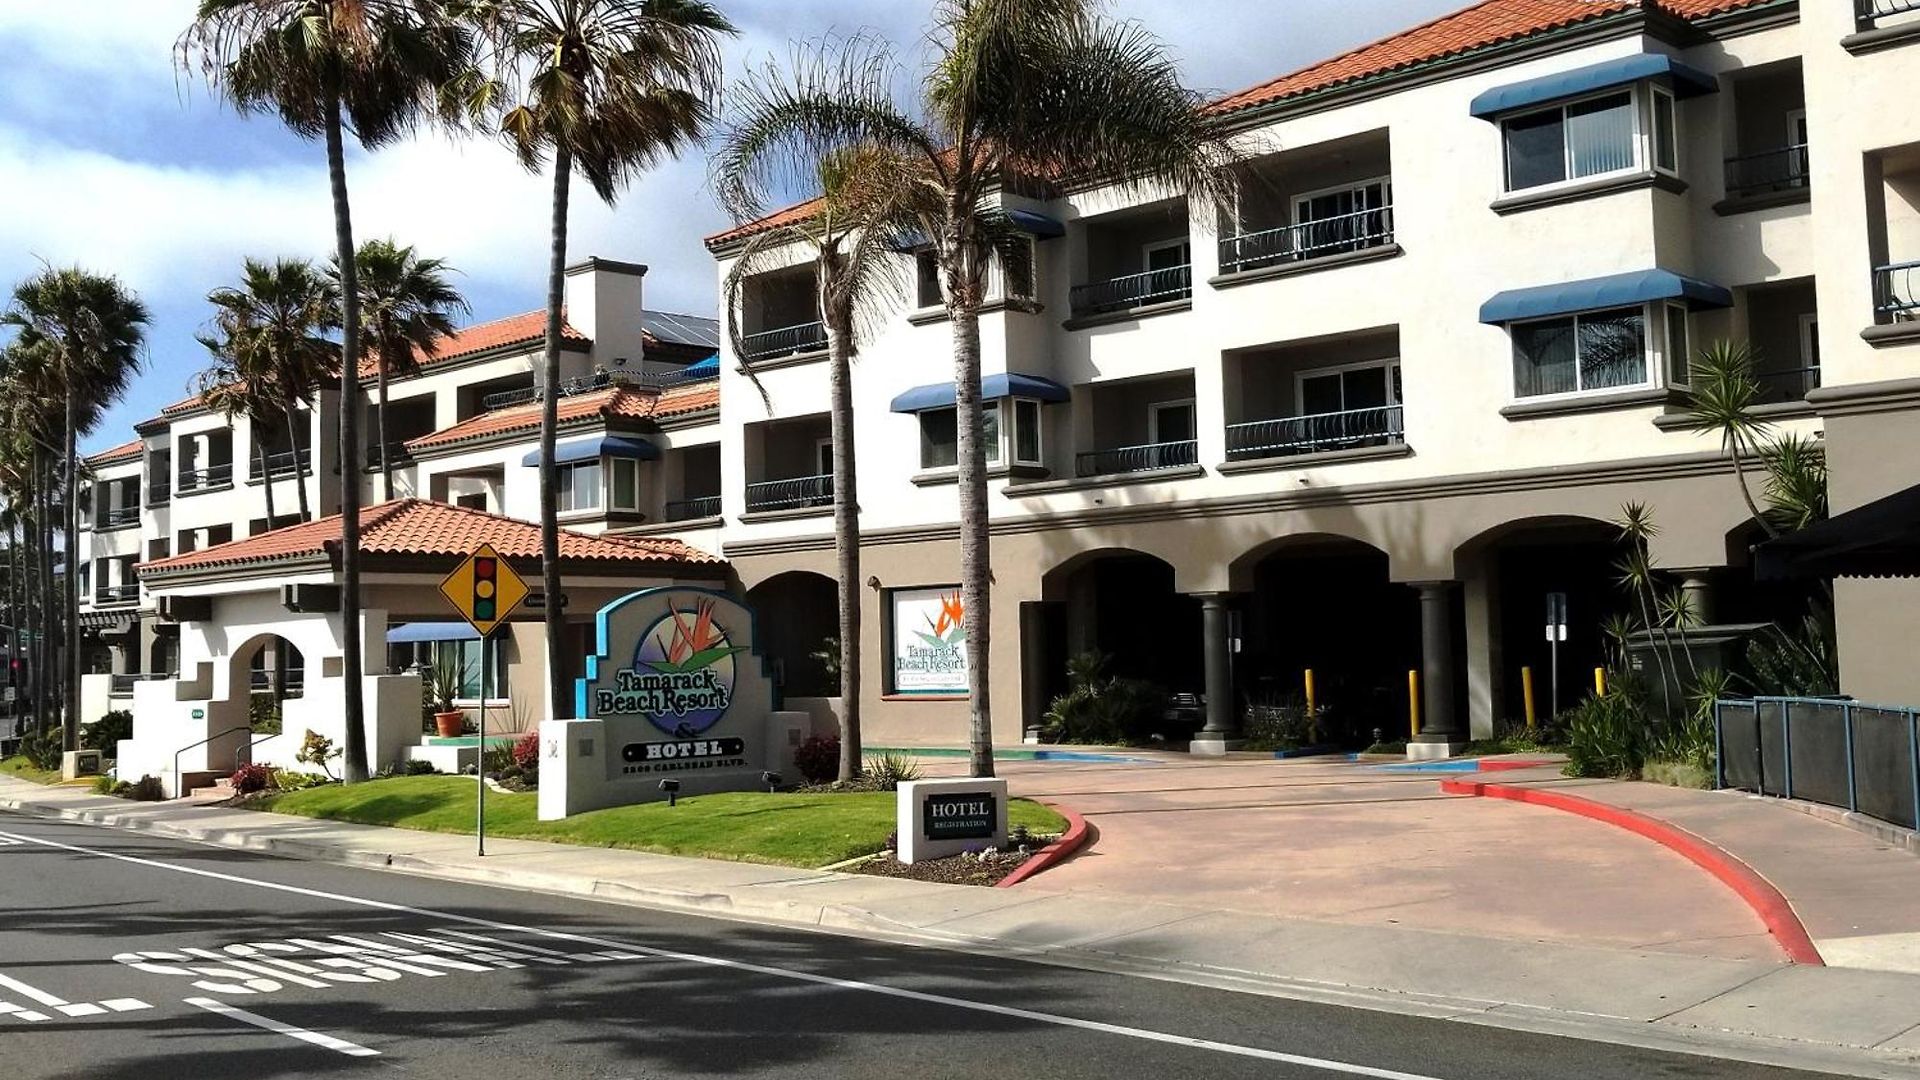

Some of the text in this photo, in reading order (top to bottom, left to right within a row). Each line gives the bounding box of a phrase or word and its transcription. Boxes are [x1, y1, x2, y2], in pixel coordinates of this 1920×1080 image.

[907, 644, 961, 659] Tamarack
[897, 656, 966, 673] Beach Resort
[618, 668, 716, 692] Tamarack
[598, 687, 728, 715] Beach Resort
[646, 741, 722, 759] HOTEL
[654, 760, 713, 771] CARLSBAD
[932, 802, 989, 817] HOTEL
[934, 820, 987, 829] REGISTRATION
[112, 927, 648, 994] SIGNAL
